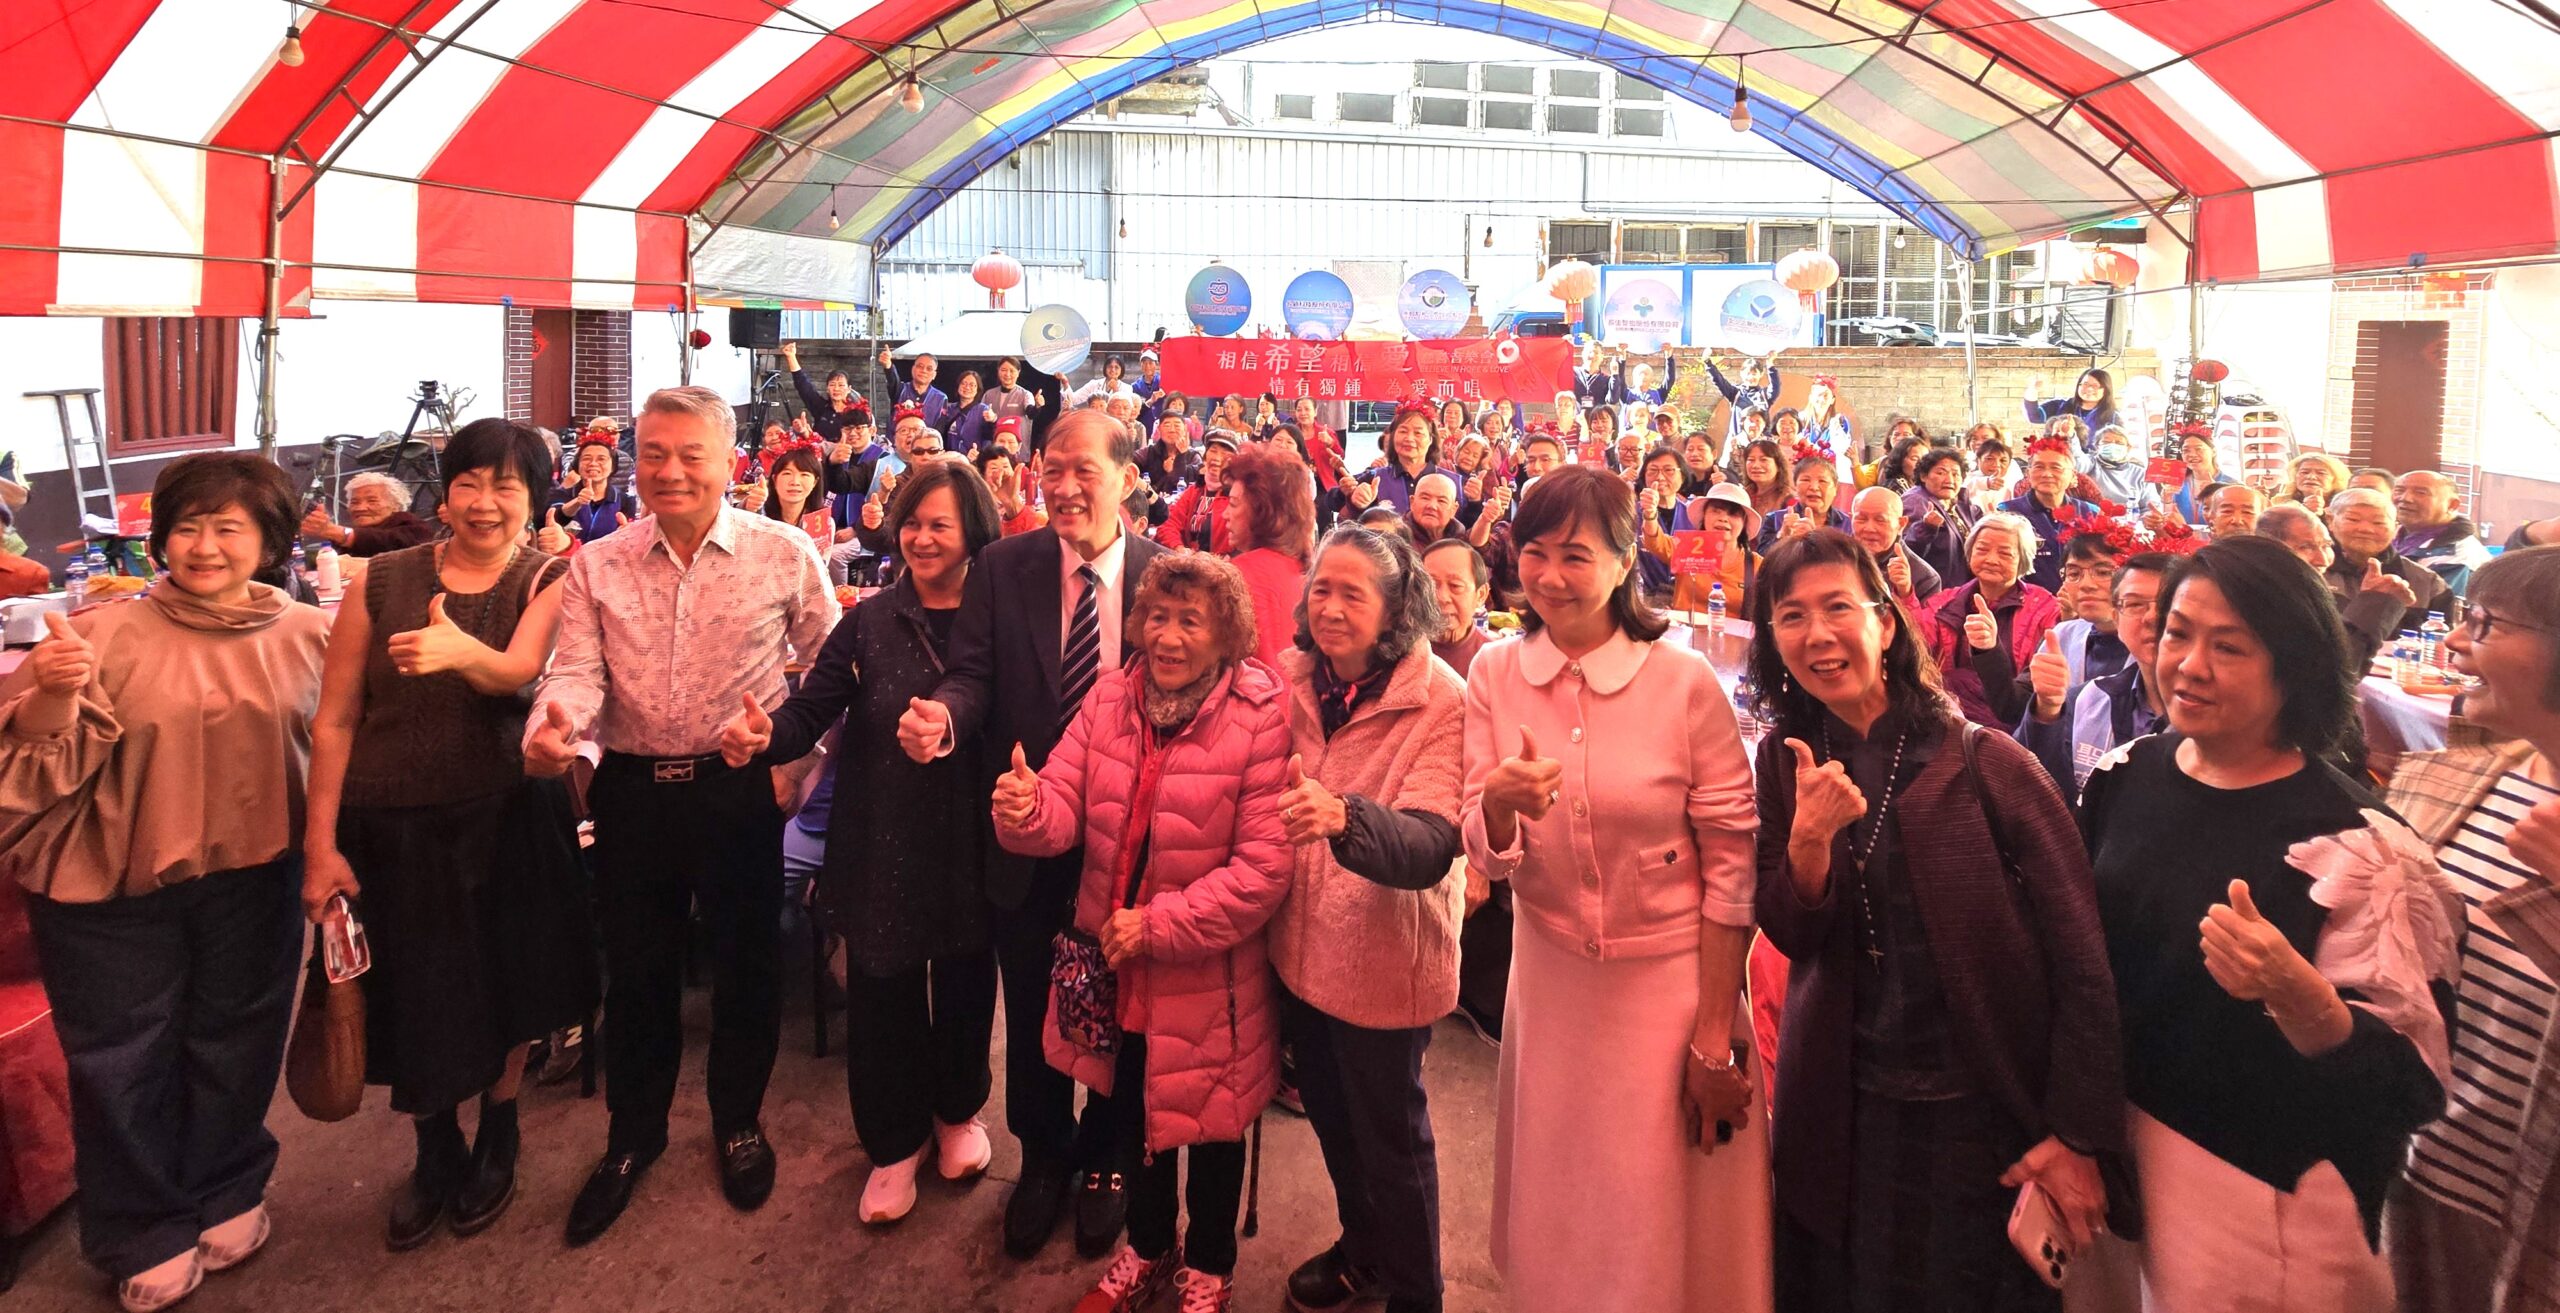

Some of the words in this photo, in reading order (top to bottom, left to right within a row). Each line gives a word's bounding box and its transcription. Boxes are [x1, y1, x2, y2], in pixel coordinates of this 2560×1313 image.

[1490, 365, 1509, 373] LOVE
[1269, 377, 1362, 397] 情有獨鍾
[1386, 378, 1482, 398] 為愛而唱
[1587, 446, 1595, 458] 6
[2160, 461, 2172, 472] 5
[140, 496, 152, 513] 4
[814, 514, 822, 533] 3
[1691, 536, 1705, 555] 2
